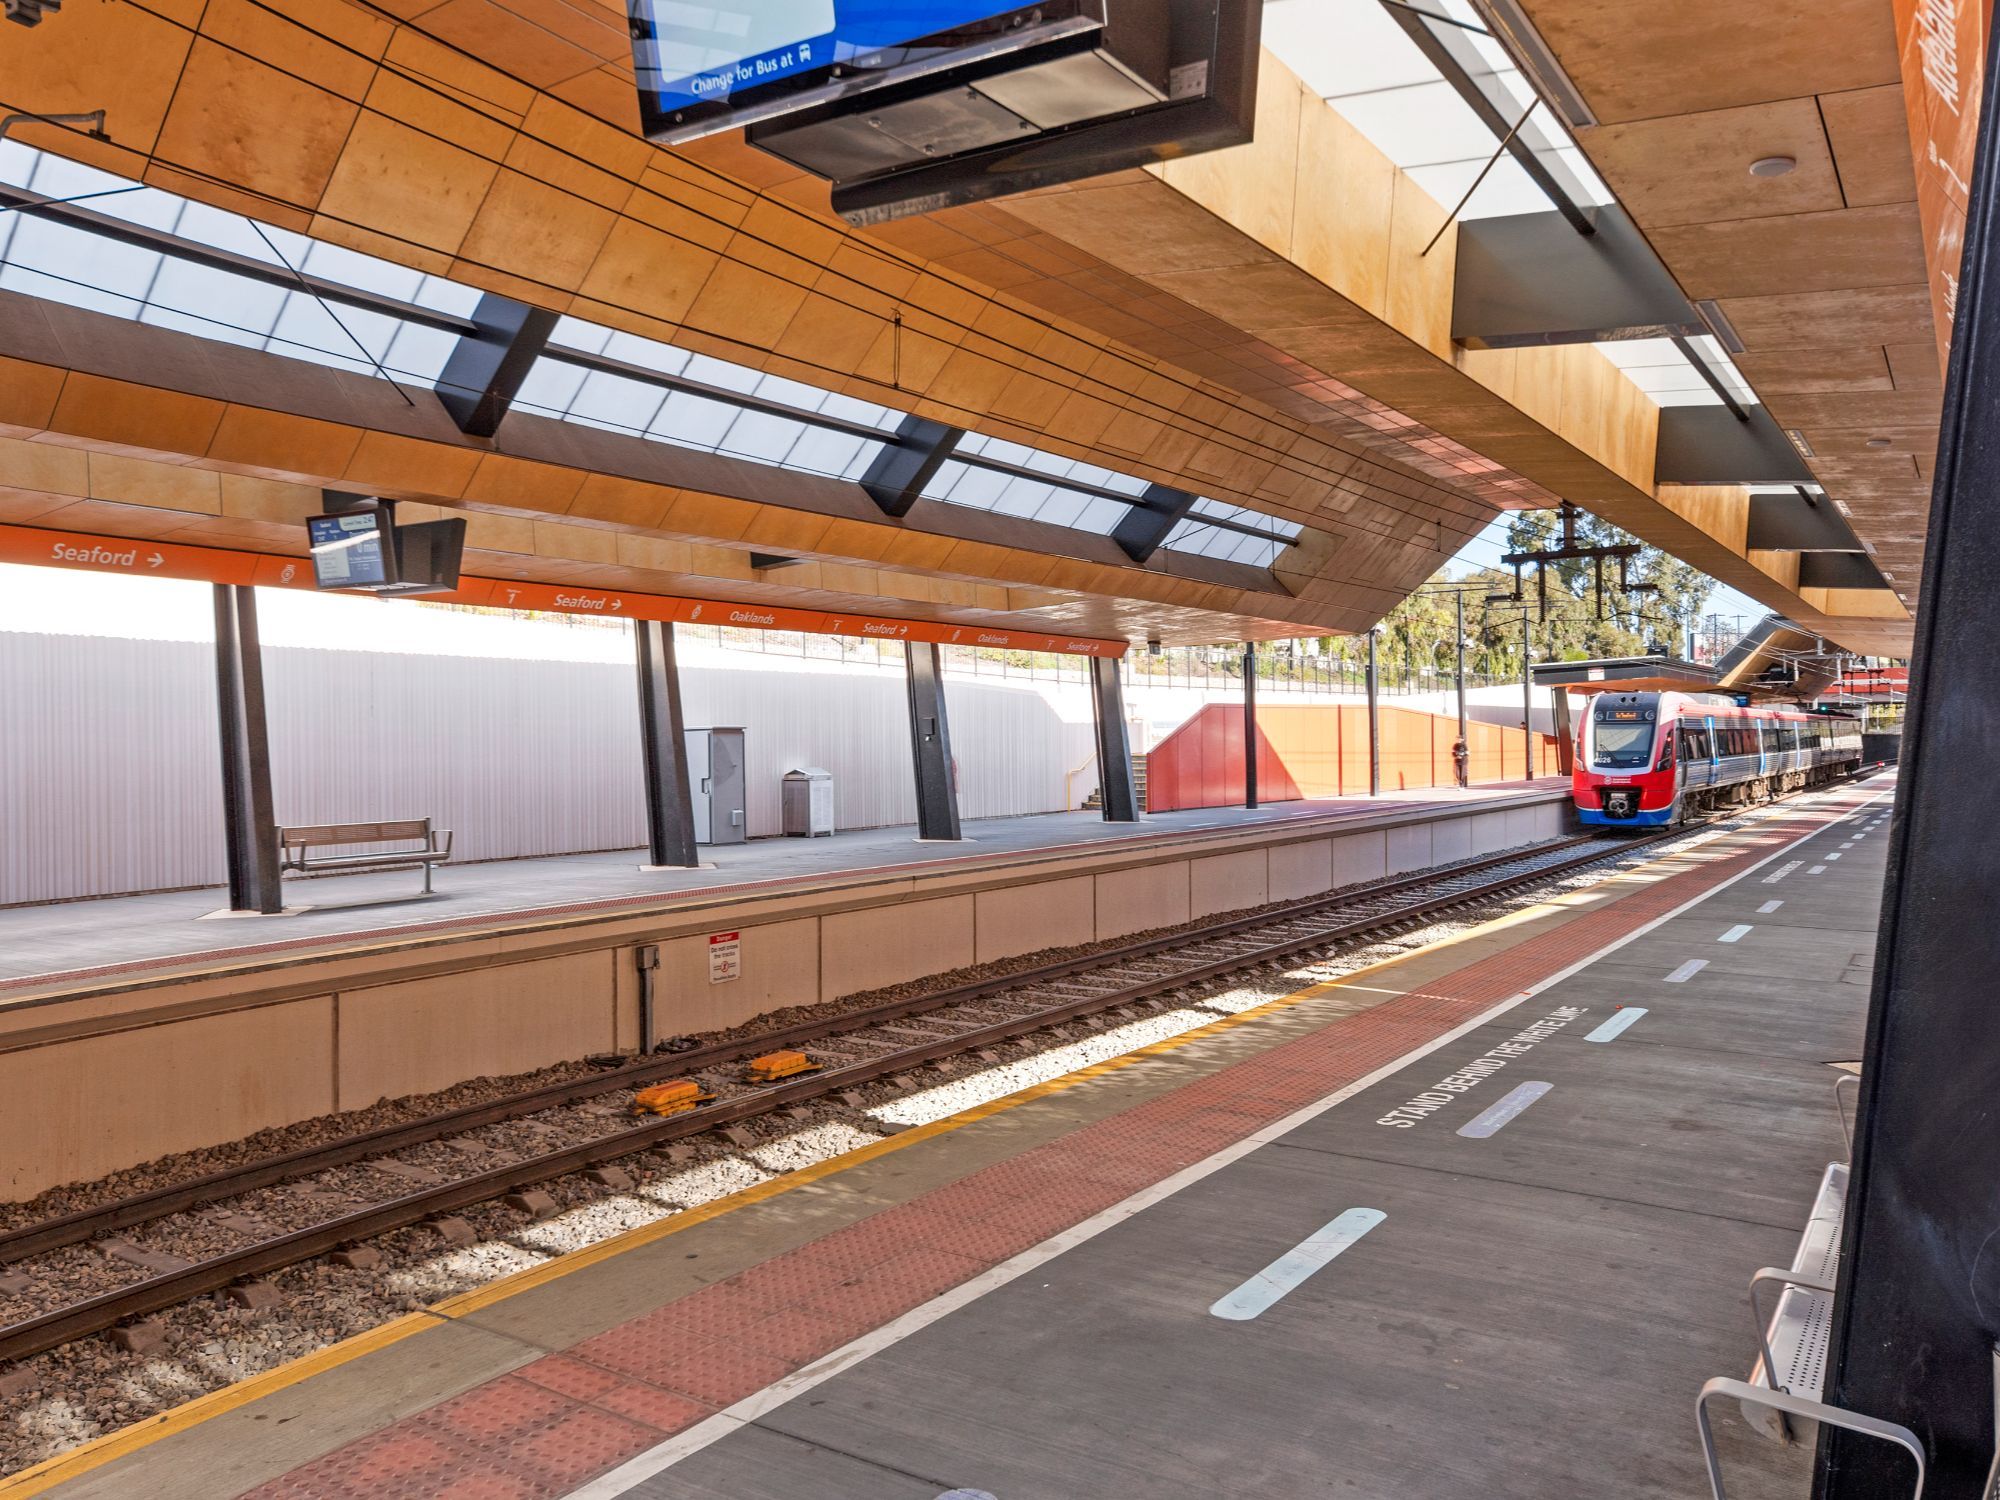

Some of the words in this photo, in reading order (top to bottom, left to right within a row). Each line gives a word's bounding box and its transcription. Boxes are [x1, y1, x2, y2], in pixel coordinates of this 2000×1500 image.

[691, 72, 734, 94] Change
[736, 65, 754, 81] for
[756, 59, 778, 75] Bus
[780, 52, 794, 68] at
[51, 543, 137, 566] Seaford
[553, 594, 607, 610] Seaford
[729, 611, 775, 625] Oaklands
[862, 622, 898, 635] Seaford
[1376, 1092, 1455, 1128] STAND
[1431, 1058, 1507, 1092] BEHIND
[1484, 1041, 1534, 1058] THE
[1509, 1020, 1567, 1043] WHITE
[1544, 1005, 1590, 1021] LINE
